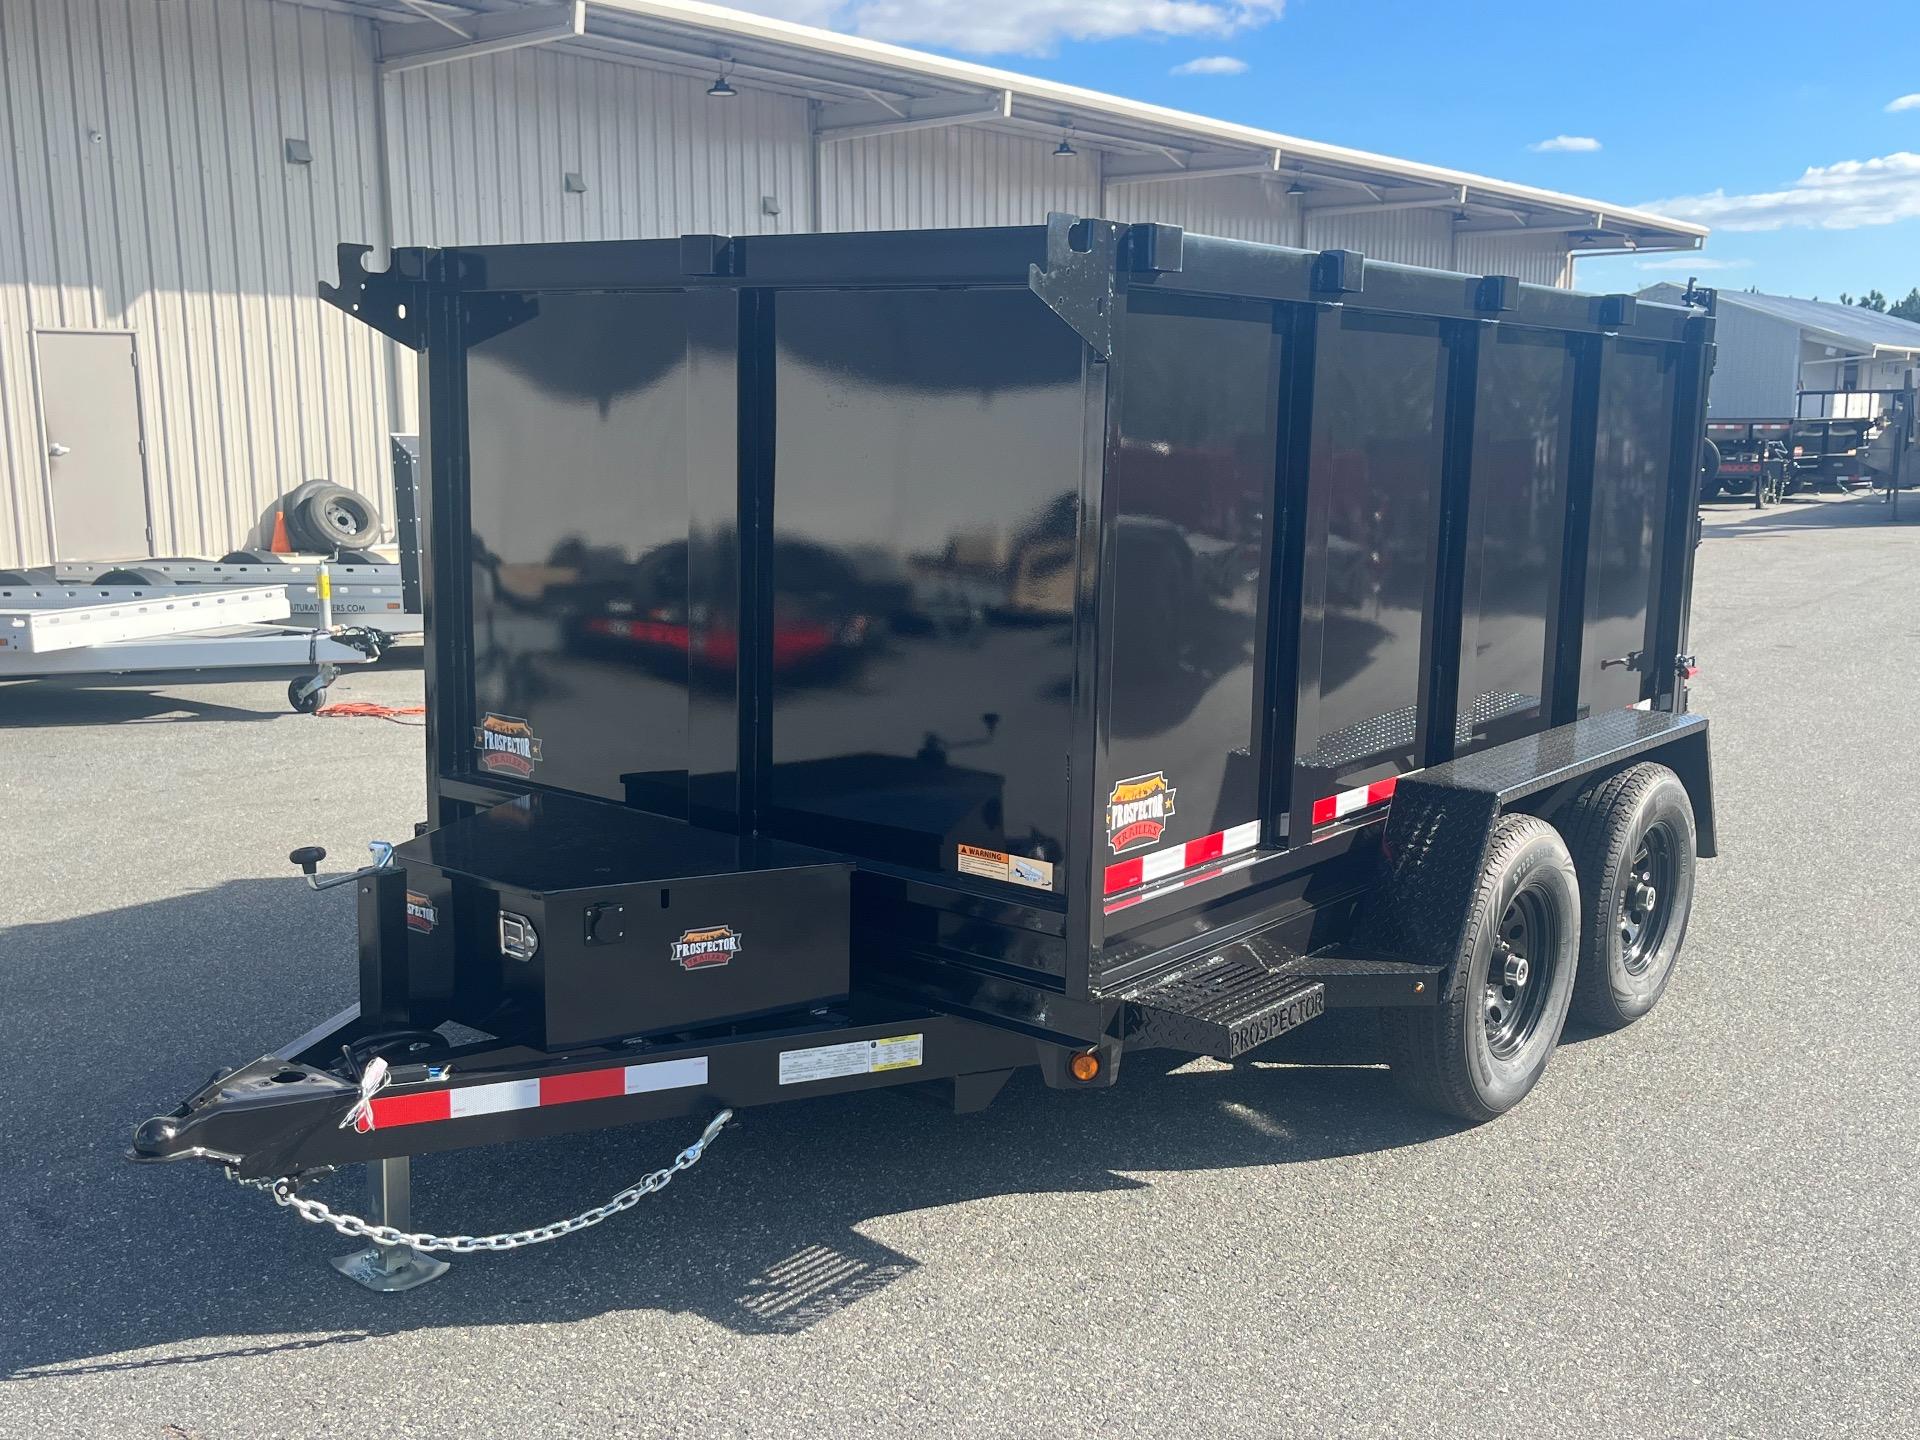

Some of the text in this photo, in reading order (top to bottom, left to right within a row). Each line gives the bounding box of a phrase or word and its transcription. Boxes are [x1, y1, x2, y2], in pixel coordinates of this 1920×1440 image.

[290, 603, 366, 613] UTURATERS.COM
[484, 729, 532, 759] PROSPECTOR
[1110, 793, 1164, 830] PROSPECTOR
[1116, 822, 1158, 845] TRAILERS
[968, 847, 1002, 861] WARNING
[407, 903, 435, 922] SPECTOR
[676, 936, 737, 958] PROSPECTOR
[1231, 991, 1323, 1056] PROSPECTOR
